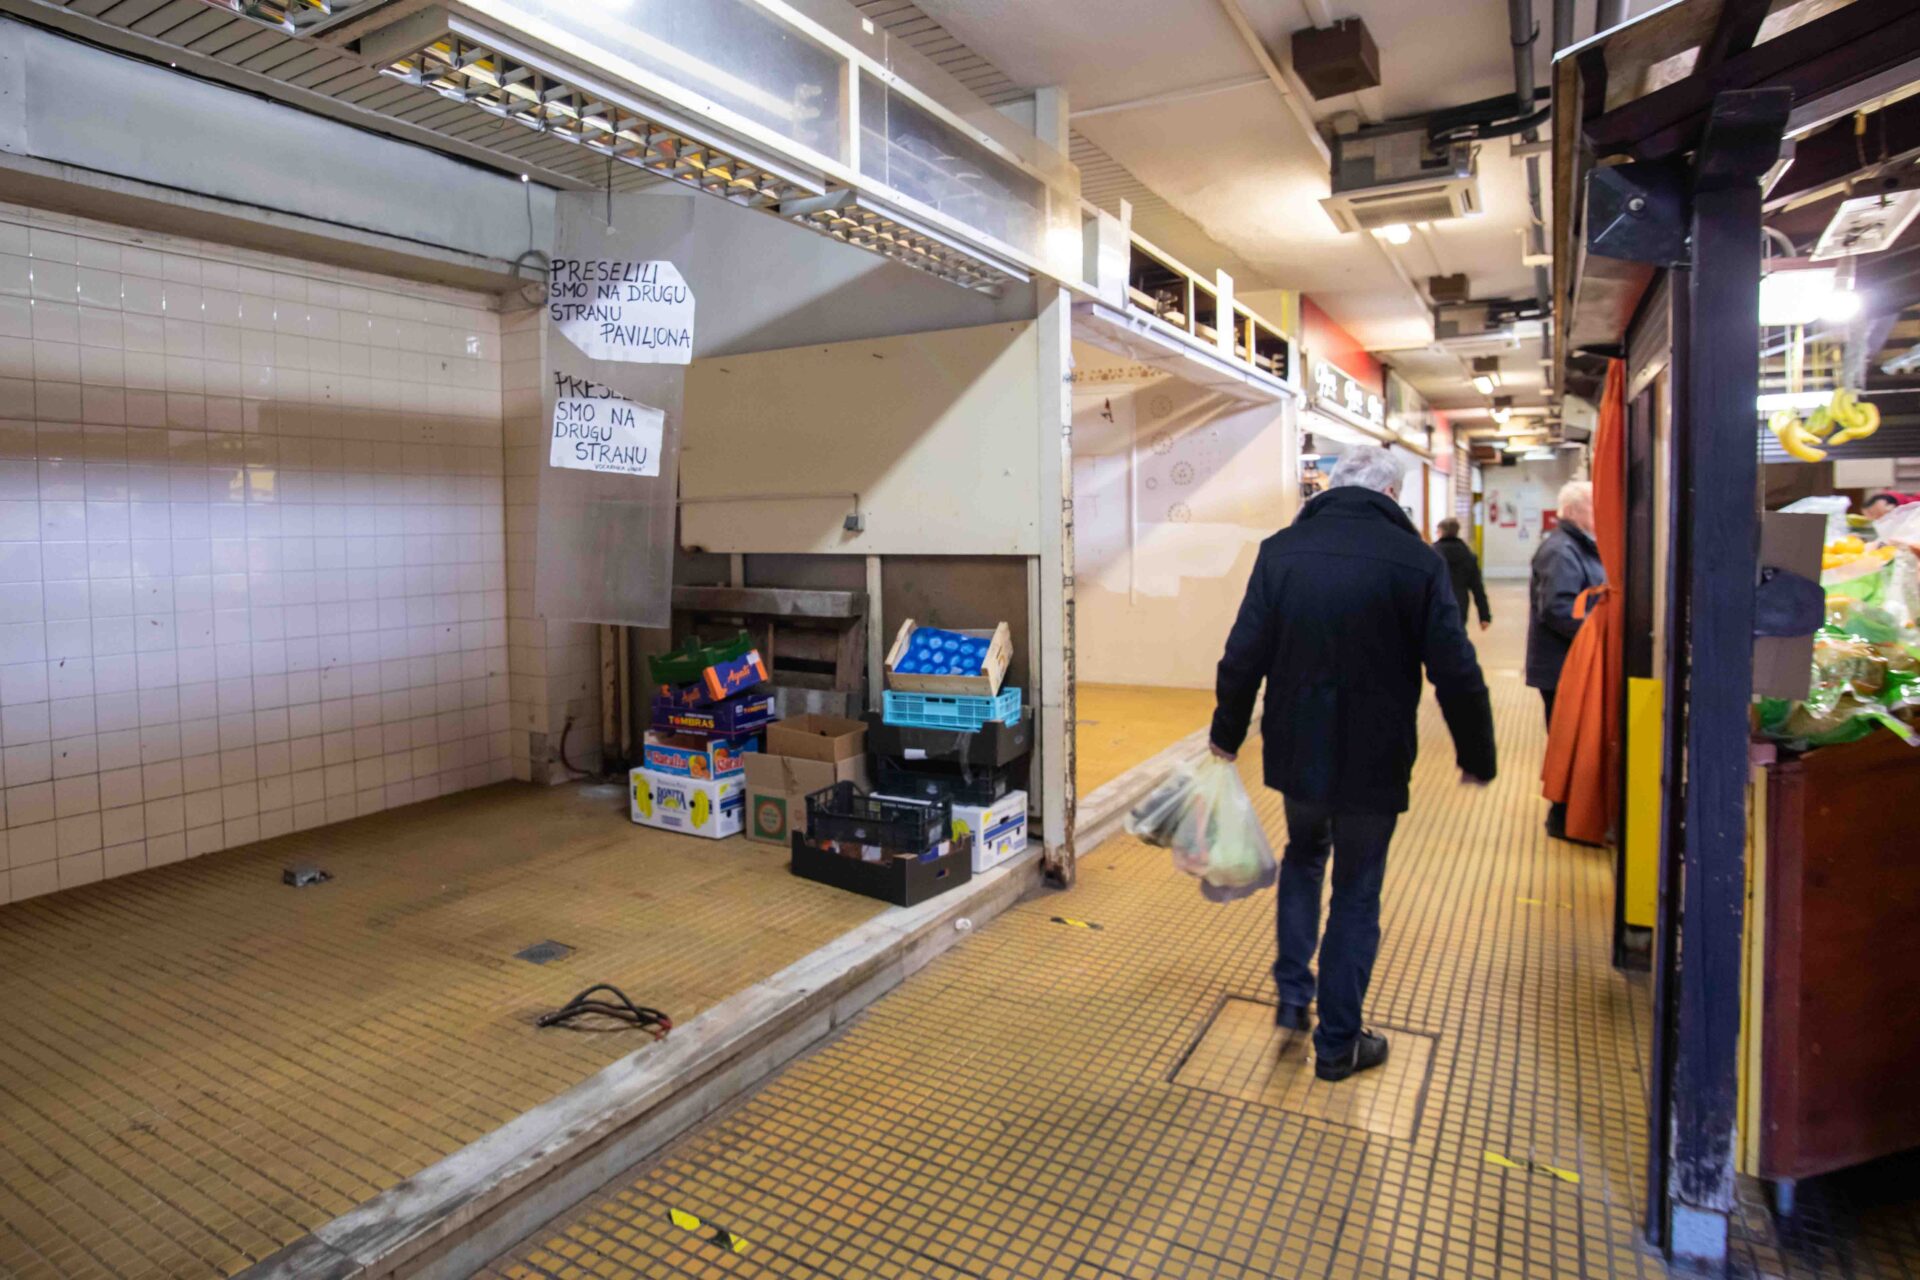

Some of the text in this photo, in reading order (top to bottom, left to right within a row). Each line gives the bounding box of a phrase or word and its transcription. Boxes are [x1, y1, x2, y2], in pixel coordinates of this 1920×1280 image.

[550, 259, 658, 284] PRESELILI
[551, 282, 687, 305] SMO NA DRUGU
[550, 303, 622, 321] STRANU
[600, 322, 690, 349] PAVILJONA
[556, 401, 635, 429] SMO NA
[555, 421, 612, 442] DRUGU
[576, 441, 647, 465] STRANU
[656, 786, 687, 810] BONITA
